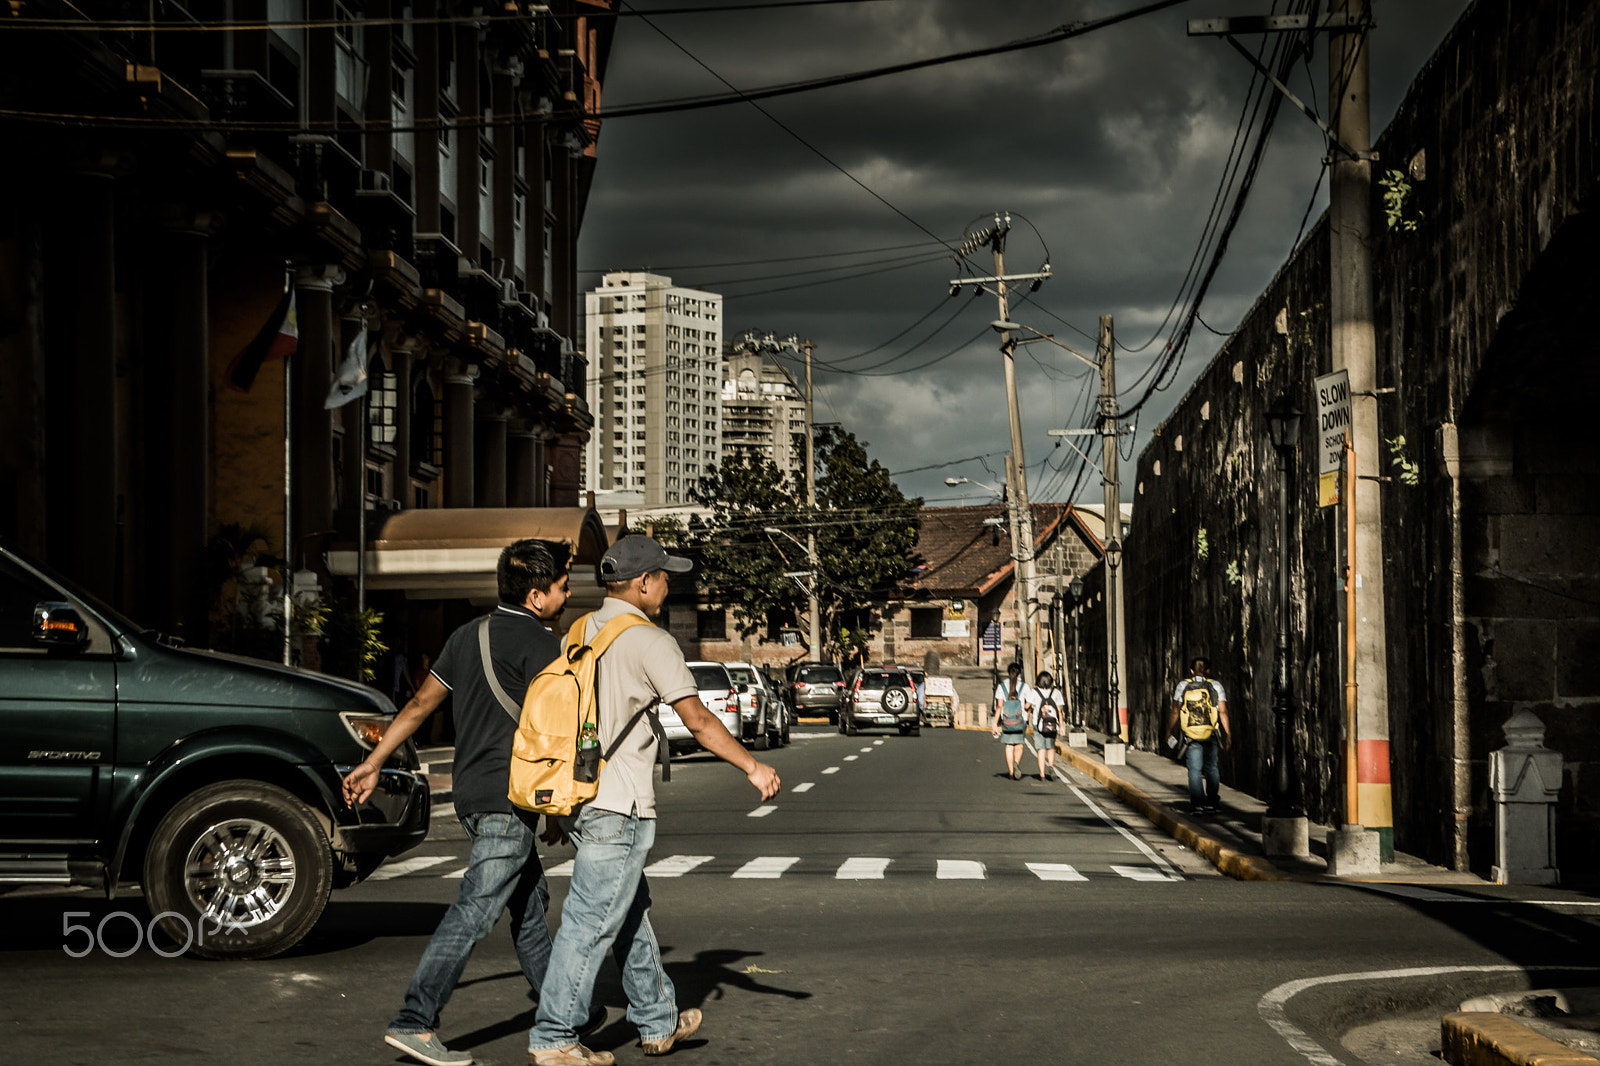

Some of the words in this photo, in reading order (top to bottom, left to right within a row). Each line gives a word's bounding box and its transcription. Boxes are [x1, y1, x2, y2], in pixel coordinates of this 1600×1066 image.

[1320, 381, 1347, 407] SLOW
[1322, 406, 1350, 432] DOWN
[1325, 432, 1347, 448] SCHOO
[1329, 450, 1341, 464] ZON
[27, 750, 101, 760] SPORTIVO
